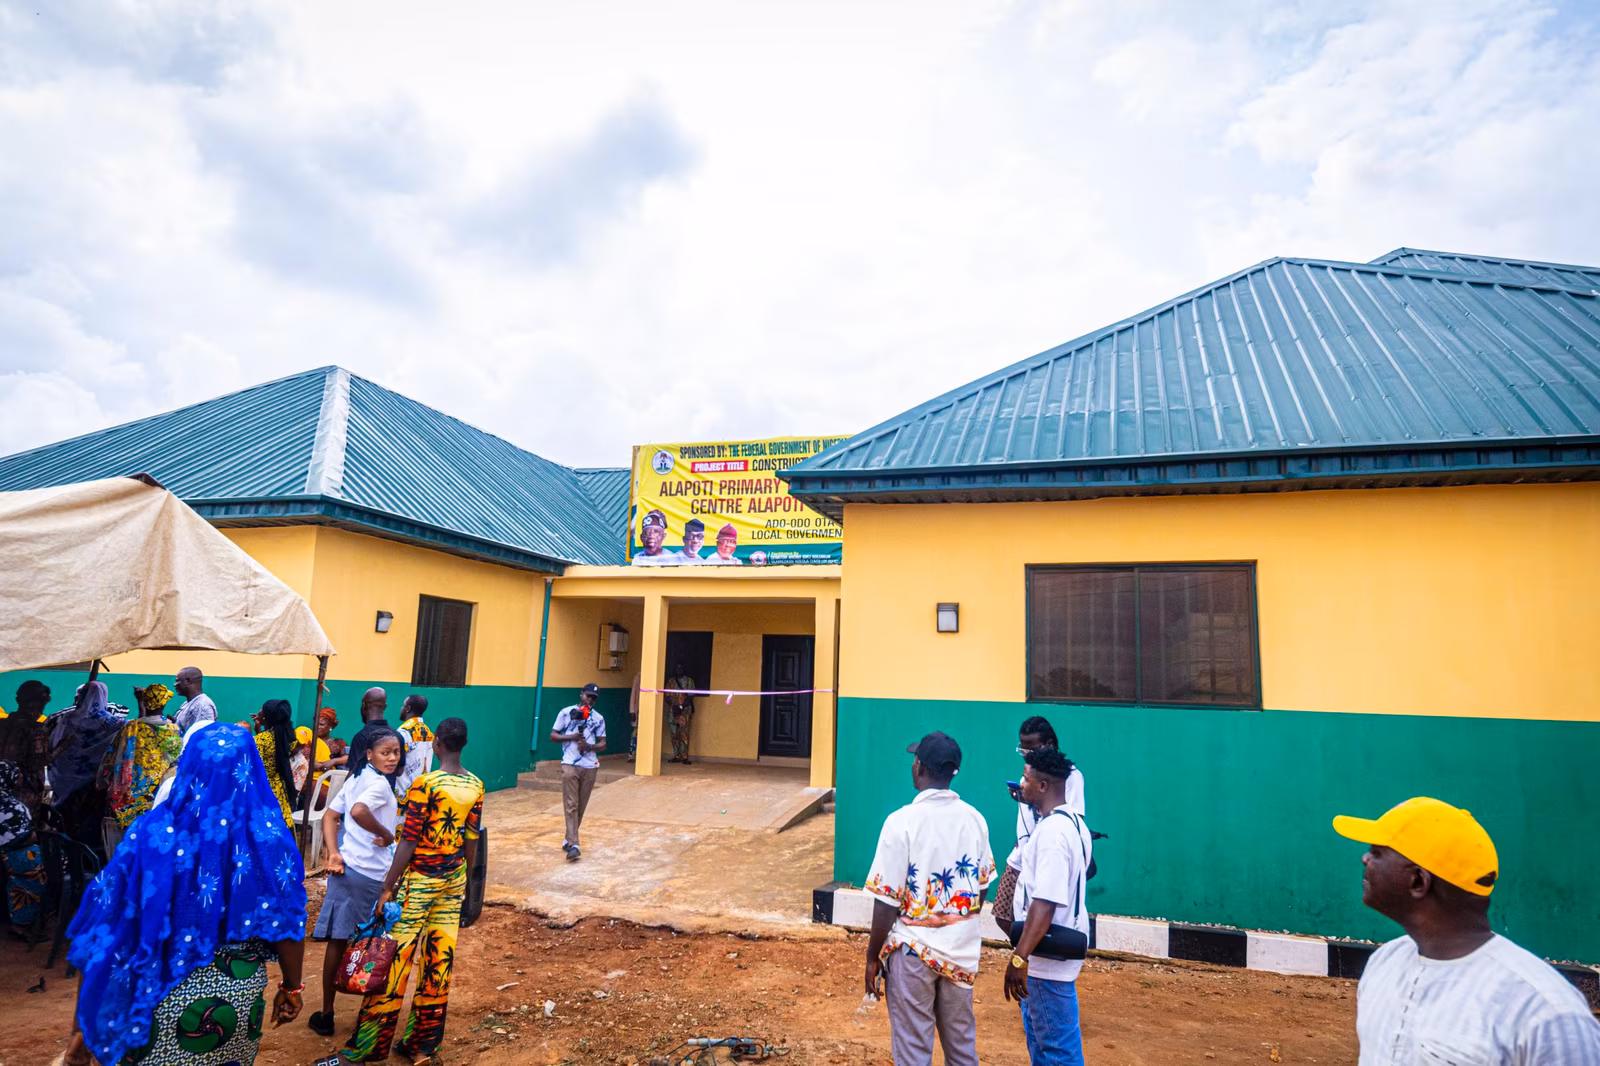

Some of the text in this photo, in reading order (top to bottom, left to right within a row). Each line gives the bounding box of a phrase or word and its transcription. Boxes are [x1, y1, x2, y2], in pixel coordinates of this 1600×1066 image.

[680, 445, 715, 459] SPONSORED
[717, 444, 728, 457] BY:
[728, 444, 740, 457] THE
[741, 443, 767, 457] FEDERAL
[769, 441, 810, 455] GOVERNMENT
[694, 461, 745, 472] PROJECT TITLE
[752, 457, 808, 471] CONSTRUC
[660, 481, 713, 496] ALAPOTI
[719, 478, 781, 495] PRIMARY
[691, 498, 743, 514] CENTRE
[765, 518, 811, 529] ADO-ODO
[752, 530, 782, 540] LOCAL
